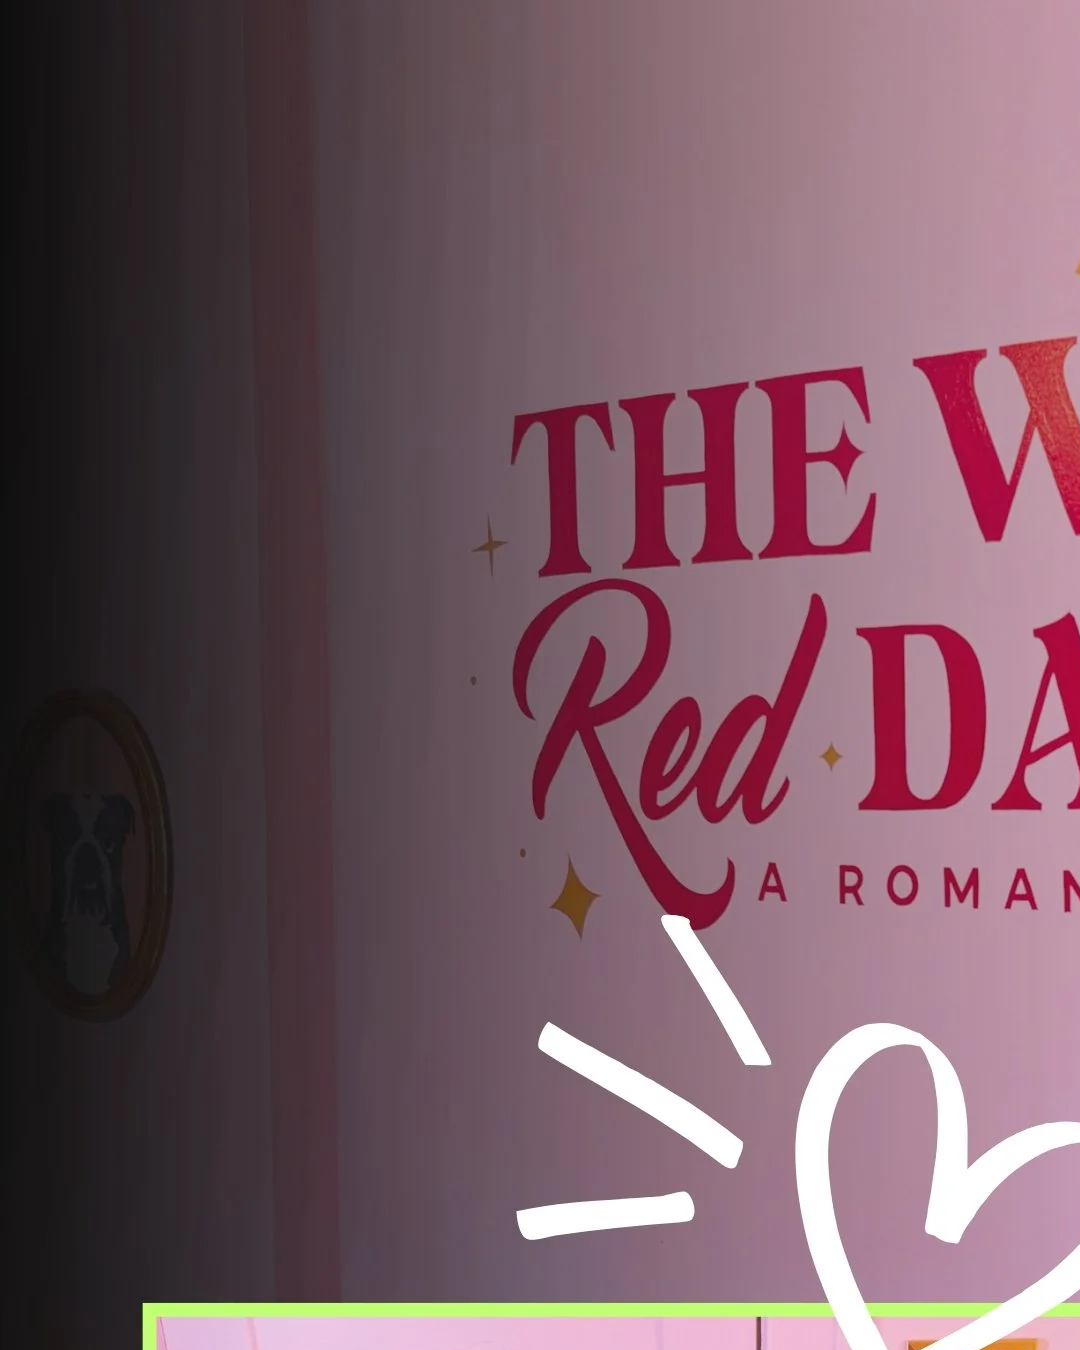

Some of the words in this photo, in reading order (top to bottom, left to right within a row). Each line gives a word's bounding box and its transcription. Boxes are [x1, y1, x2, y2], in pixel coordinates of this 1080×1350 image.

[510, 366, 877, 577] THE
[512, 578, 827, 931] Red
[758, 862, 788, 902] A
